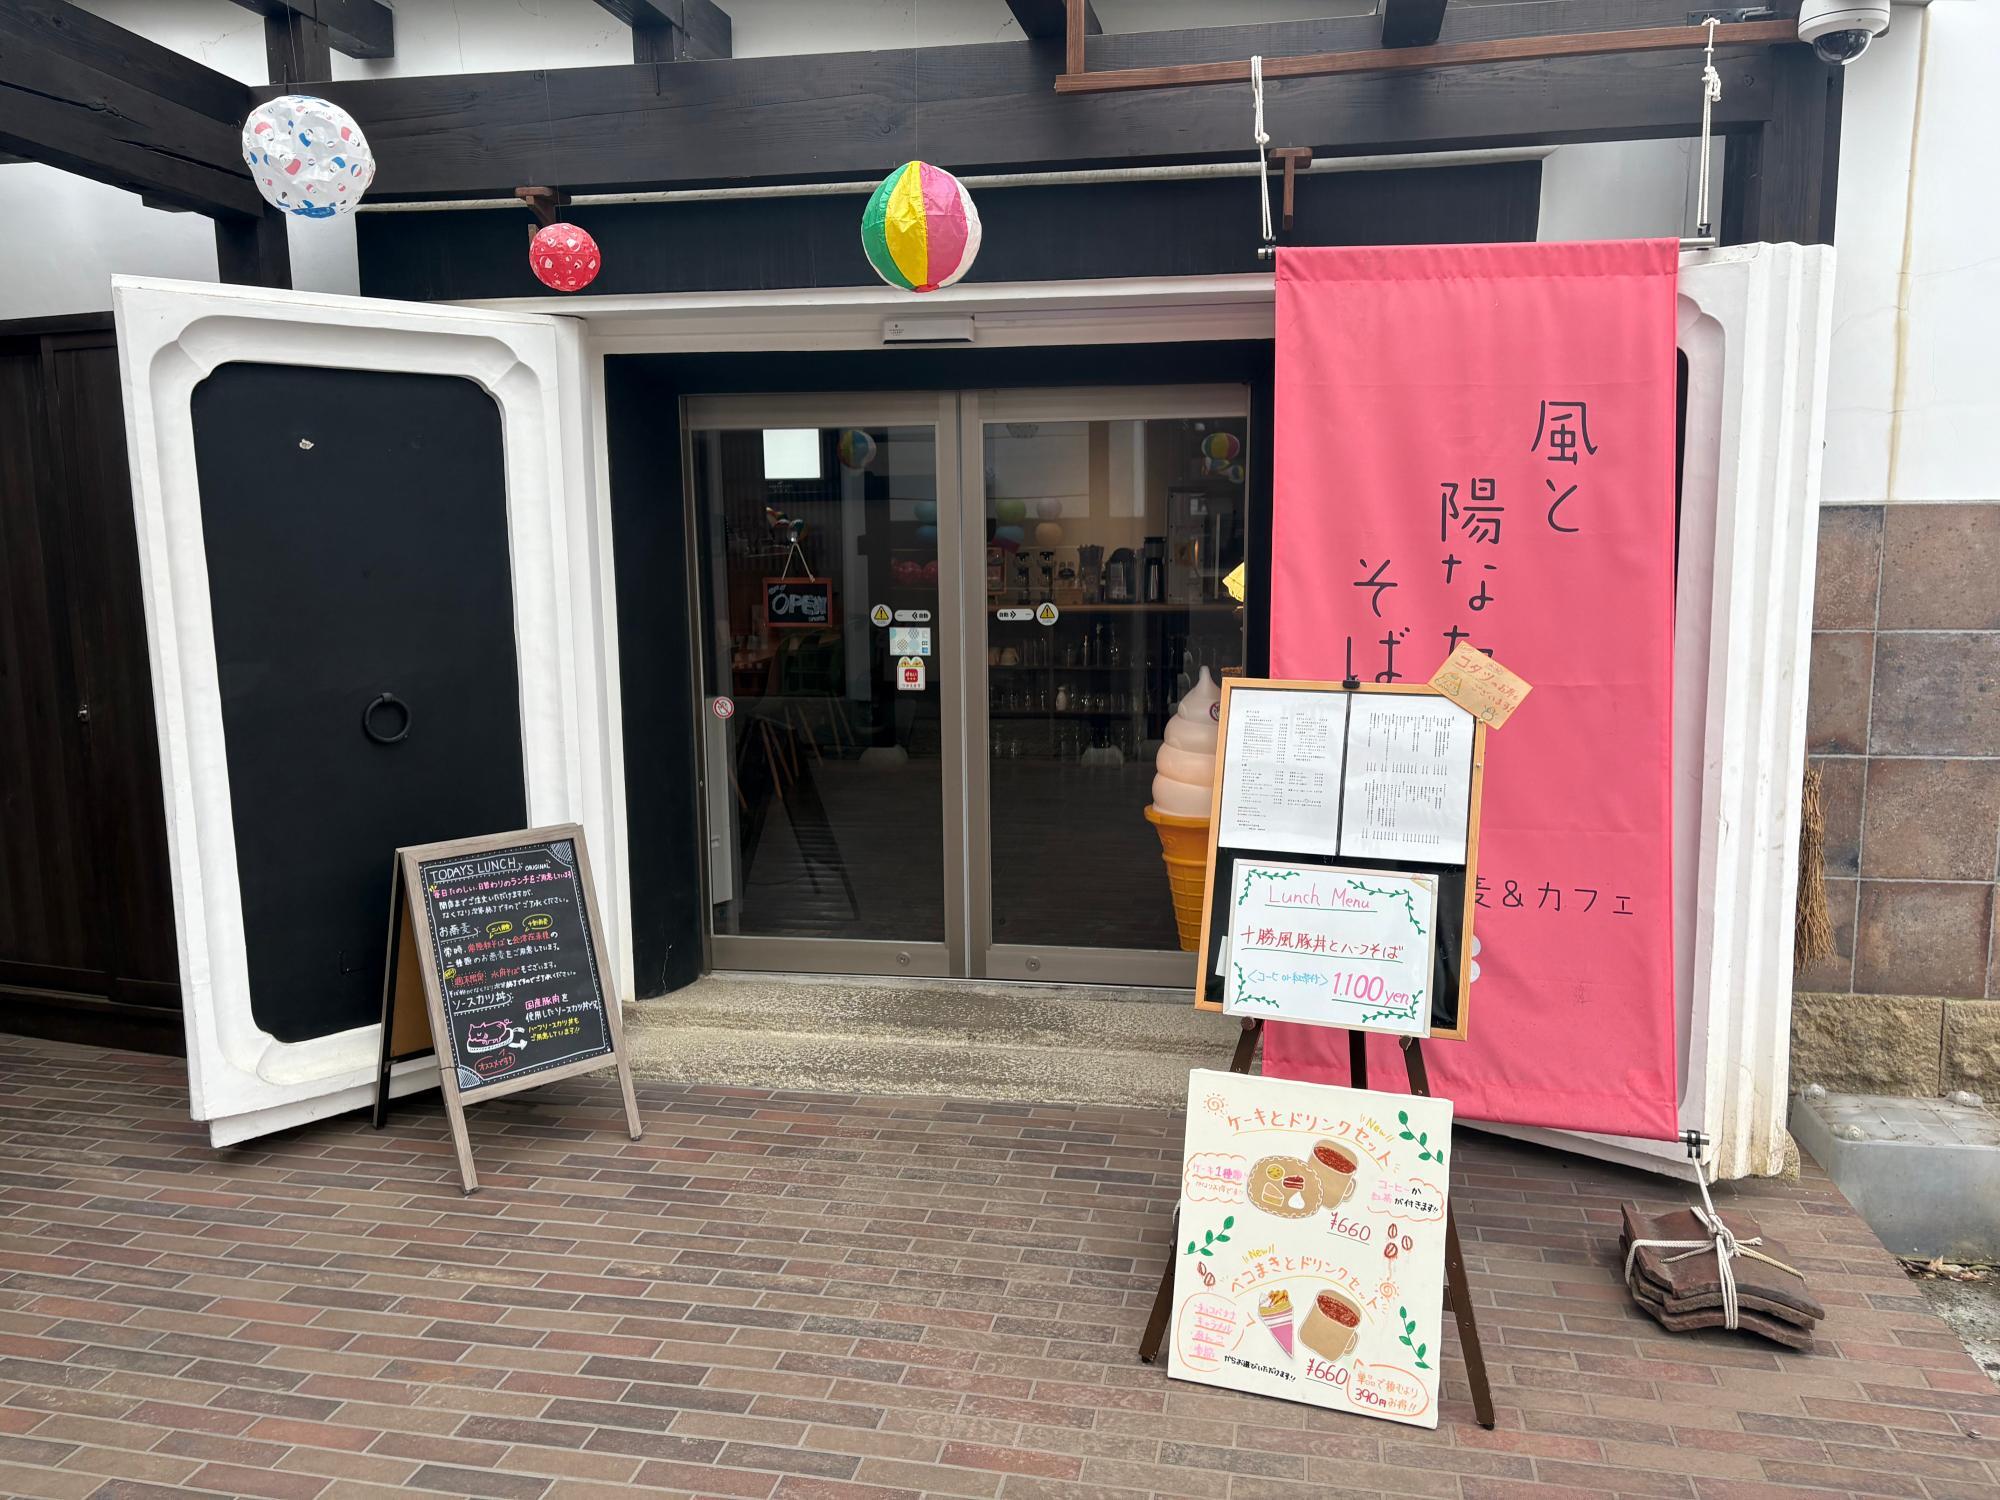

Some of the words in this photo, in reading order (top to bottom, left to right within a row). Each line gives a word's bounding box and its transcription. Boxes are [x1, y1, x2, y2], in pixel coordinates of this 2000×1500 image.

[1531, 400, 1598, 532] 風と
[772, 593, 827, 615] OPEN
[430, 865, 474, 880] TODAY'S
[478, 857, 516, 872] LUNCH
[1268, 884, 1321, 907] Lunch
[1330, 888, 1372, 910] Menu
[1240, 925, 1404, 960] 十勝風豚丼とハーフそば
[453, 992, 506, 1010] ソースカツ丼
[525, 994, 569, 1010] 国産豚肉を
[1384, 990, 1409, 1006] yen
[1228, 1107, 1393, 1169] ケーキとドリンクセット
[1330, 1212, 1371, 1242] ¥660
[1306, 1358, 1348, 1386] ¥660
